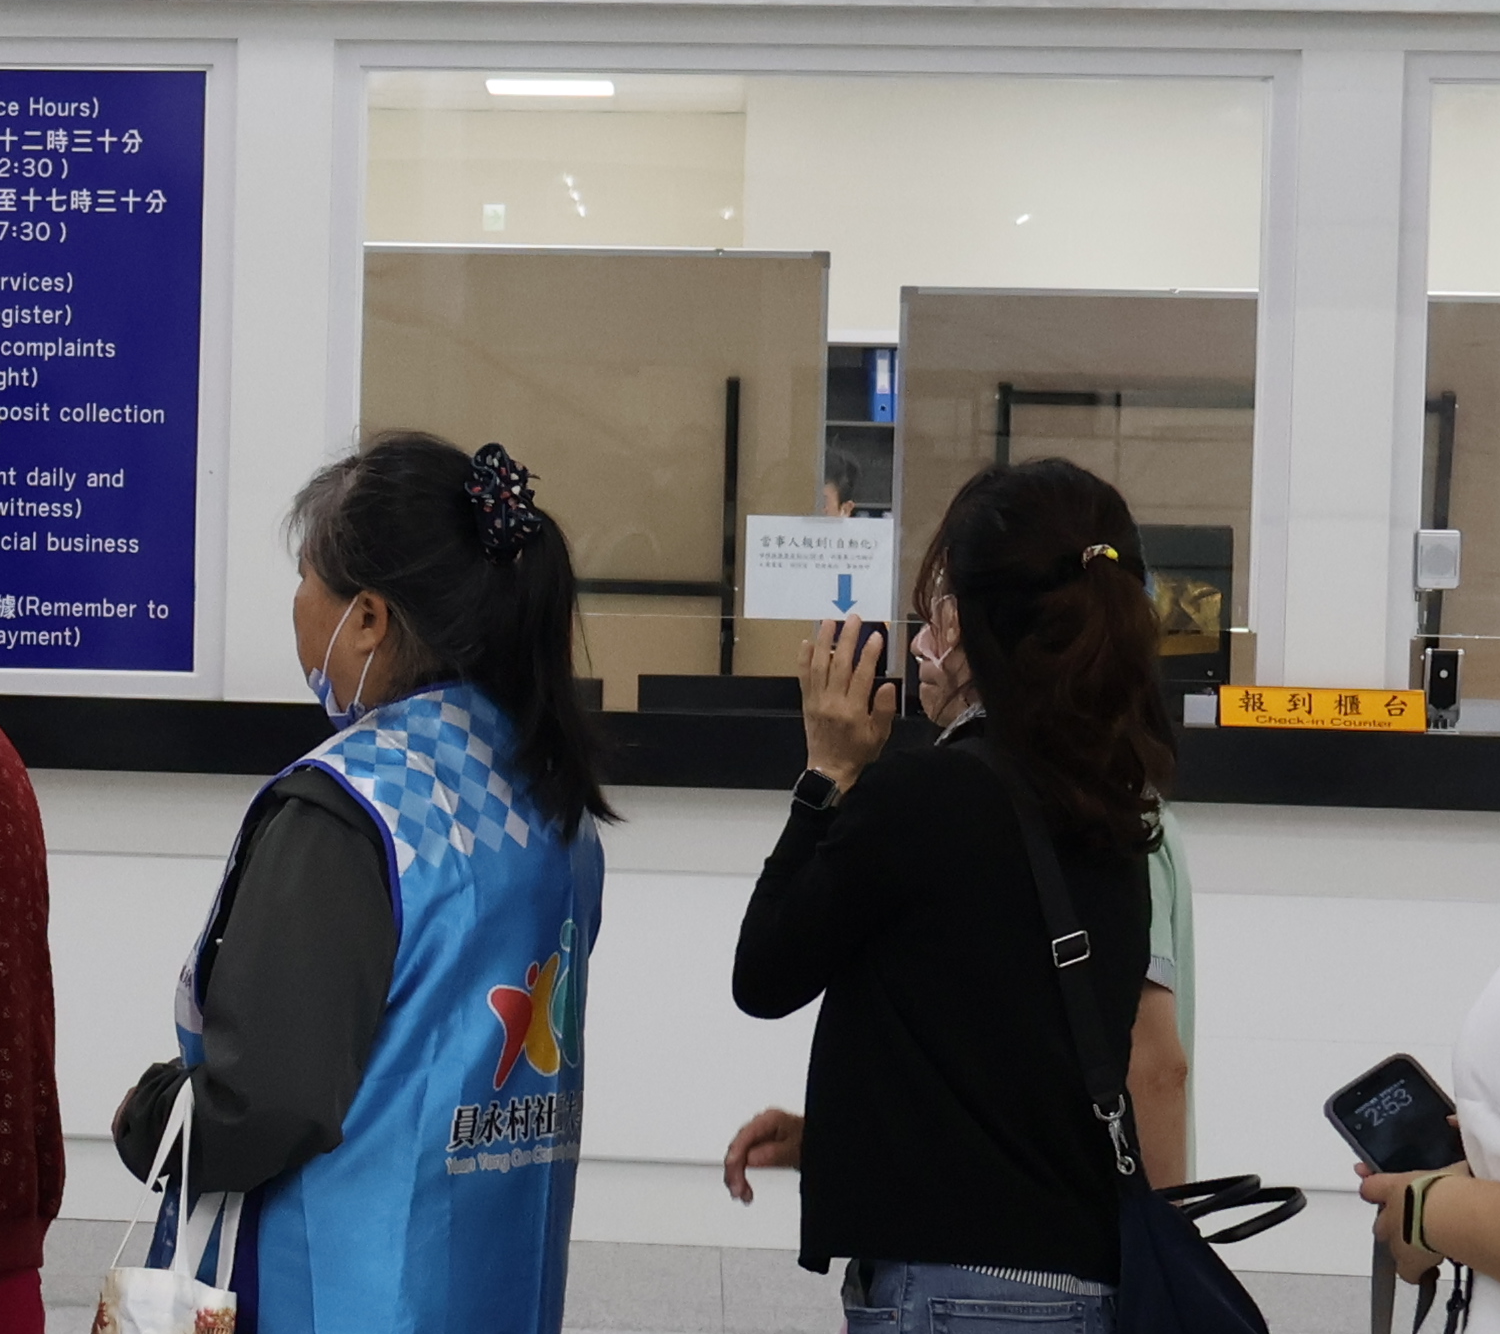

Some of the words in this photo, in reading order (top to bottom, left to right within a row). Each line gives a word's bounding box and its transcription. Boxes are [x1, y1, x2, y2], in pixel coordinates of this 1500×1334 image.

[30, 96, 99, 119] Hours)
[0, 336, 116, 362] complaints
[59, 403, 165, 424] collection
[26, 467, 77, 492] daily
[86, 468, 125, 488] and
[47, 532, 140, 554] business
[147, 599, 169, 619] to
[1239, 690, 1408, 717] 報到櫃台
[1255, 714, 1325, 726] Check-in
[1330, 717, 1392, 728] Counter
[1364, 1088, 1413, 1127] 2:53
